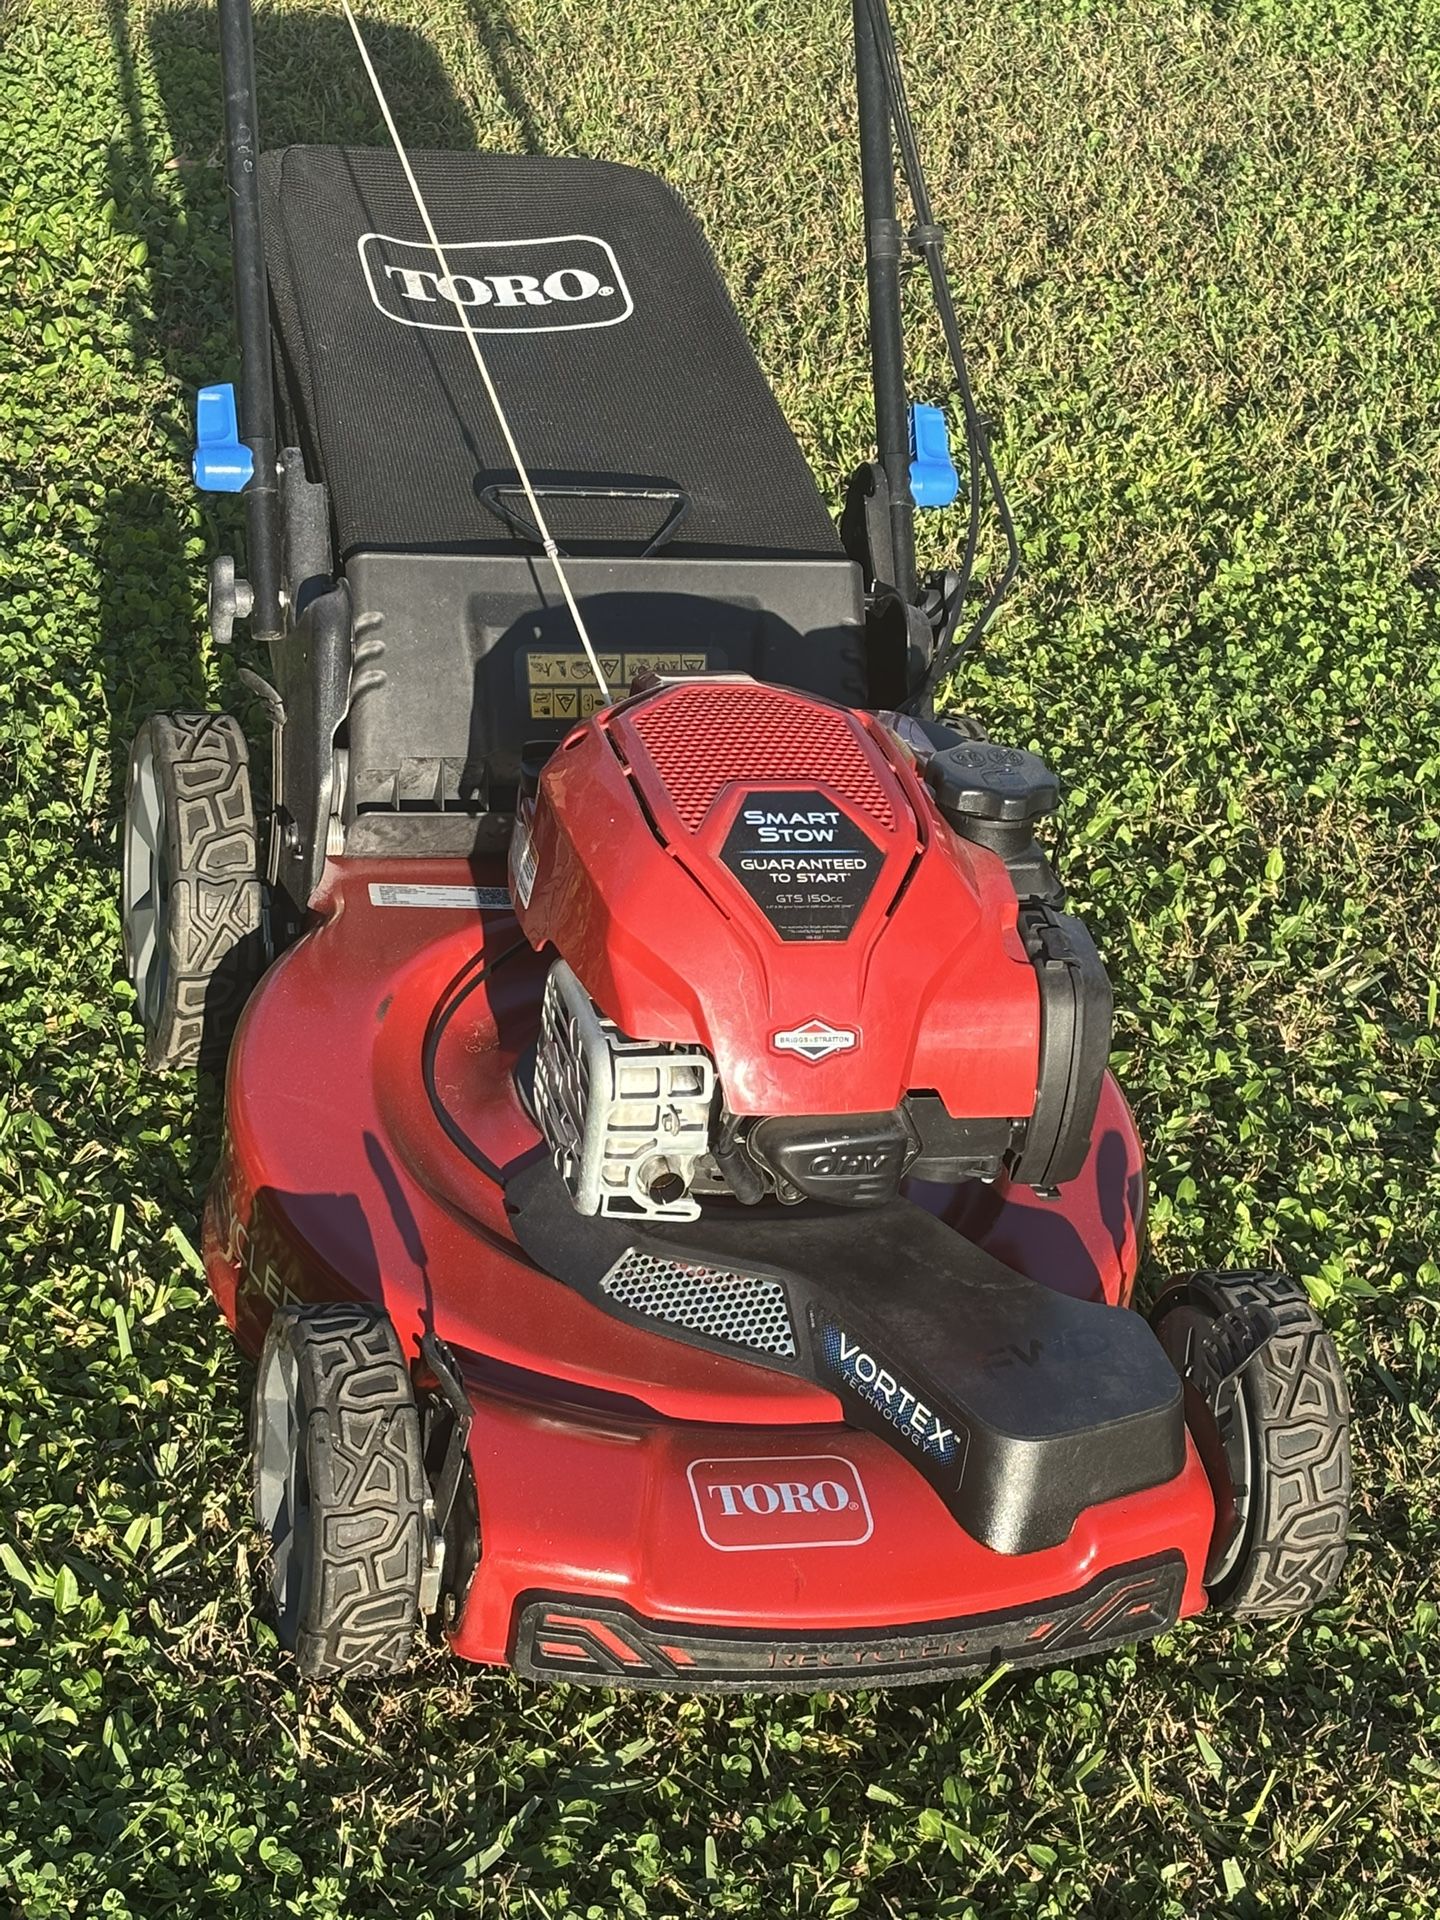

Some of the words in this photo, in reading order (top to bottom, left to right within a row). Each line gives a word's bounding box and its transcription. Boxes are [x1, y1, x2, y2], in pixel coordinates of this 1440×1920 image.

[743, 810, 840, 825] SMART
[740, 858, 867, 871] GUARANTEED
[769, 873, 791, 884] TO
[775, 894, 804, 903] GTS
[839, 1332, 953, 1452] VORTEX
[842, 1370, 931, 1453] TECHNOLOGY
[767, 1640, 969, 1669] RECYCLER
